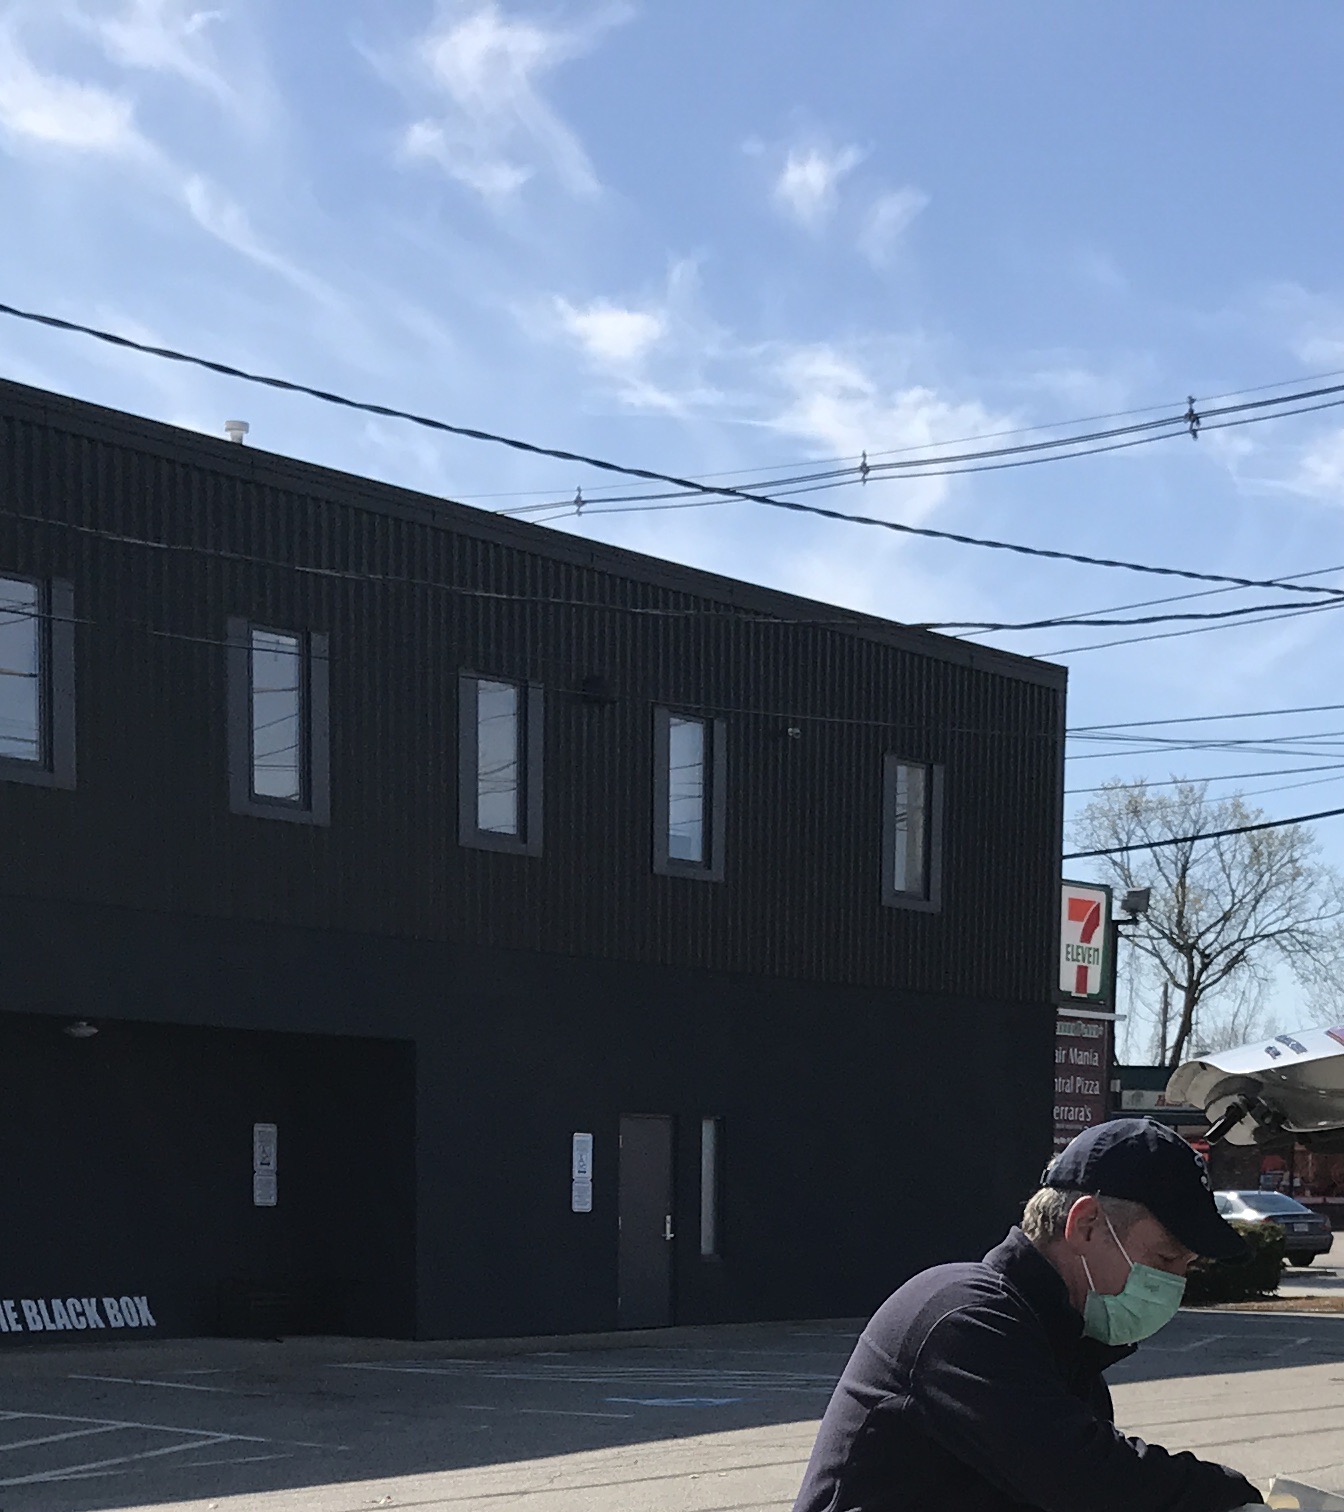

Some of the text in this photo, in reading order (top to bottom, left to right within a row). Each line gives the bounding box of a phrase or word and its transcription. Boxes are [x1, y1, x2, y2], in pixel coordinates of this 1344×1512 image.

[1068, 1047, 1099, 1067] Mania
[1075, 1076, 1100, 1095] Pizza
[20, 1297, 105, 1331] BLACK
[102, 1296, 156, 1329] BOX
